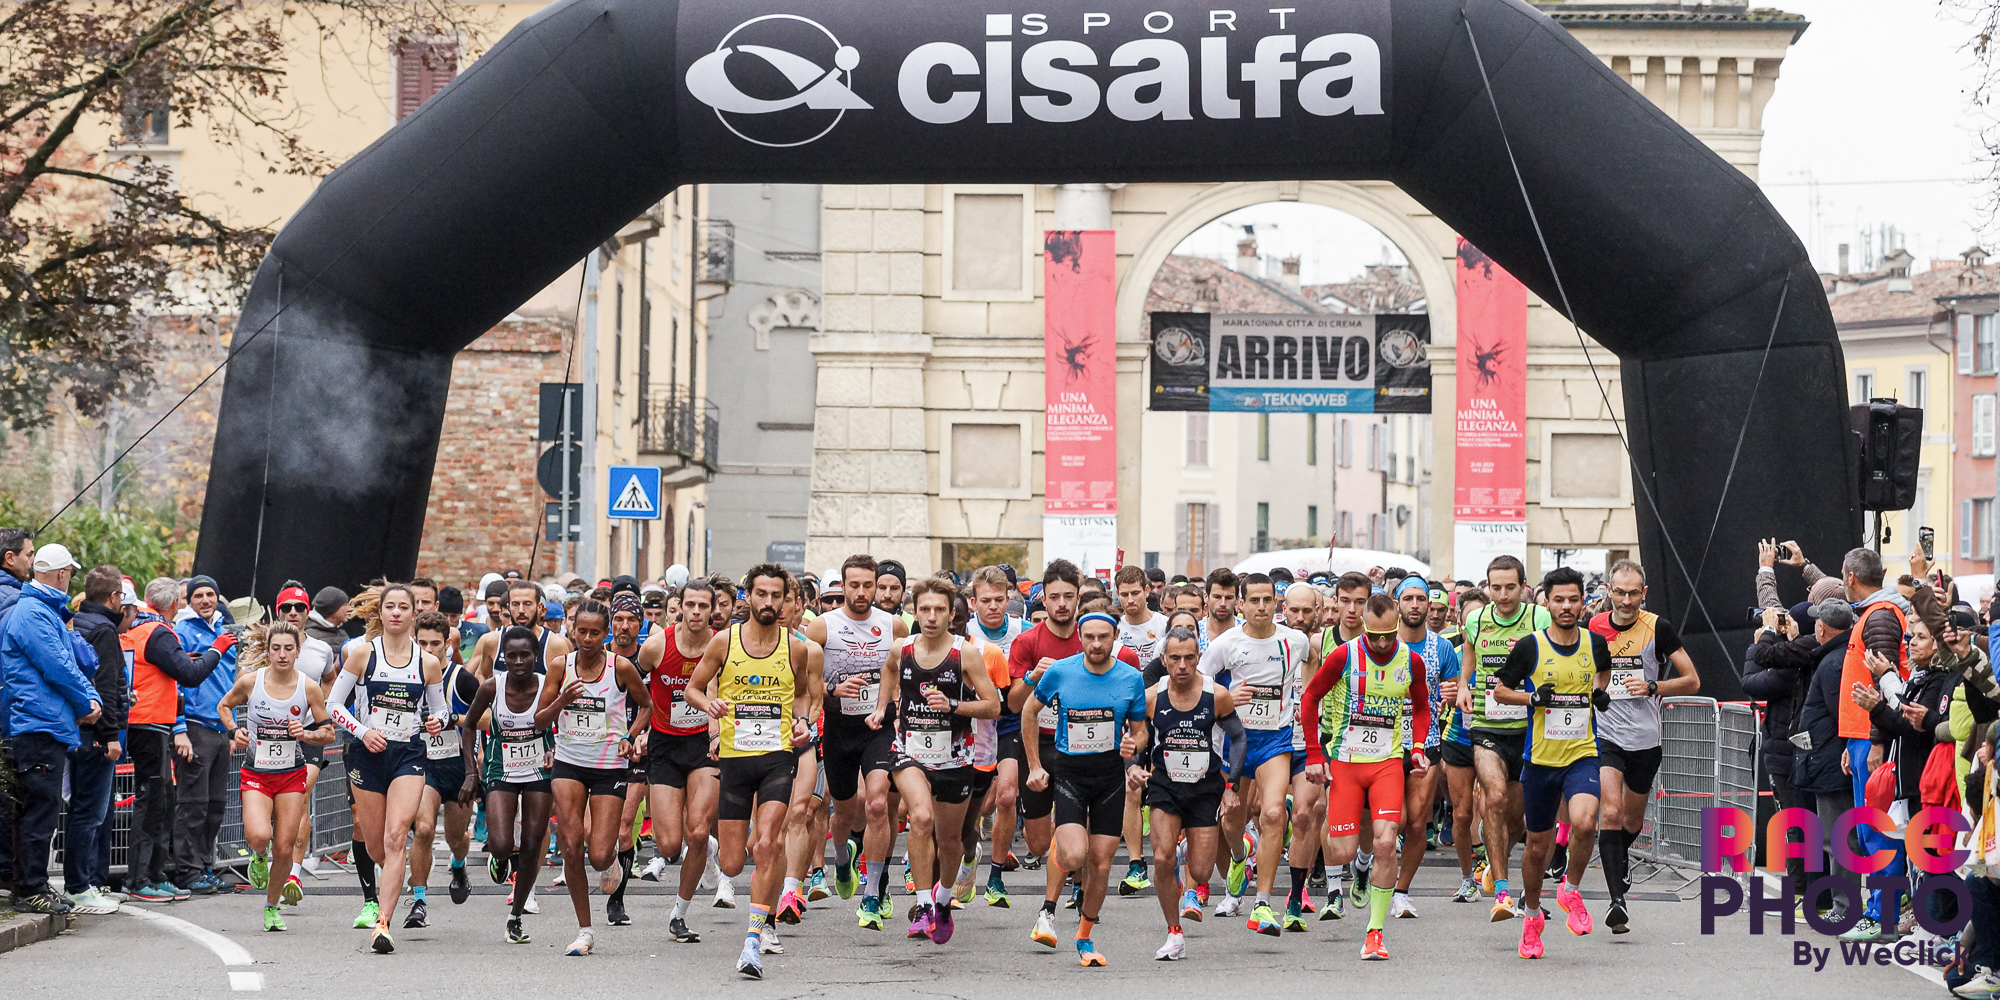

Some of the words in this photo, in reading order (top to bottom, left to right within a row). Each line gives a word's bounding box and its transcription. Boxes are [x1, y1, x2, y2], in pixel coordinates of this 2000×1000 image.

[1021, 8, 1297, 35] SPORT
[897, 14, 1385, 124] cisalfa
[1222, 319, 1284, 328] MARATONINA
[1317, 319, 1328, 328] DI
[1329, 319, 1363, 329] CREMA
[1216, 335, 1370, 381] ARRIVO
[1060, 392, 1087, 403] UNA
[1262, 392, 1348, 407] TEKNOWEB
[1470, 398, 1498, 409] UNA
[1047, 403, 1095, 414] MINIMA
[1457, 409, 1505, 420] MINIMA
[1047, 414, 1108, 425] ELEGANZA
[1457, 421, 1517, 431] ELEGANZA
[1249, 702, 1270, 716] 751
[385, 713, 401, 727] F4
[577, 715, 590, 728] F1
[1564, 713, 1572, 725] 6
[754, 723, 762, 736] 3
[1087, 727, 1095, 739] 5
[429, 735, 444, 747] 20
[925, 736, 932, 748] 8
[1362, 730, 1378, 744] 26
[269, 744, 283, 757] F3
[510, 742, 537, 759] F171
[1182, 755, 1190, 768] 4
[1330, 822, 1355, 832] INEOS
